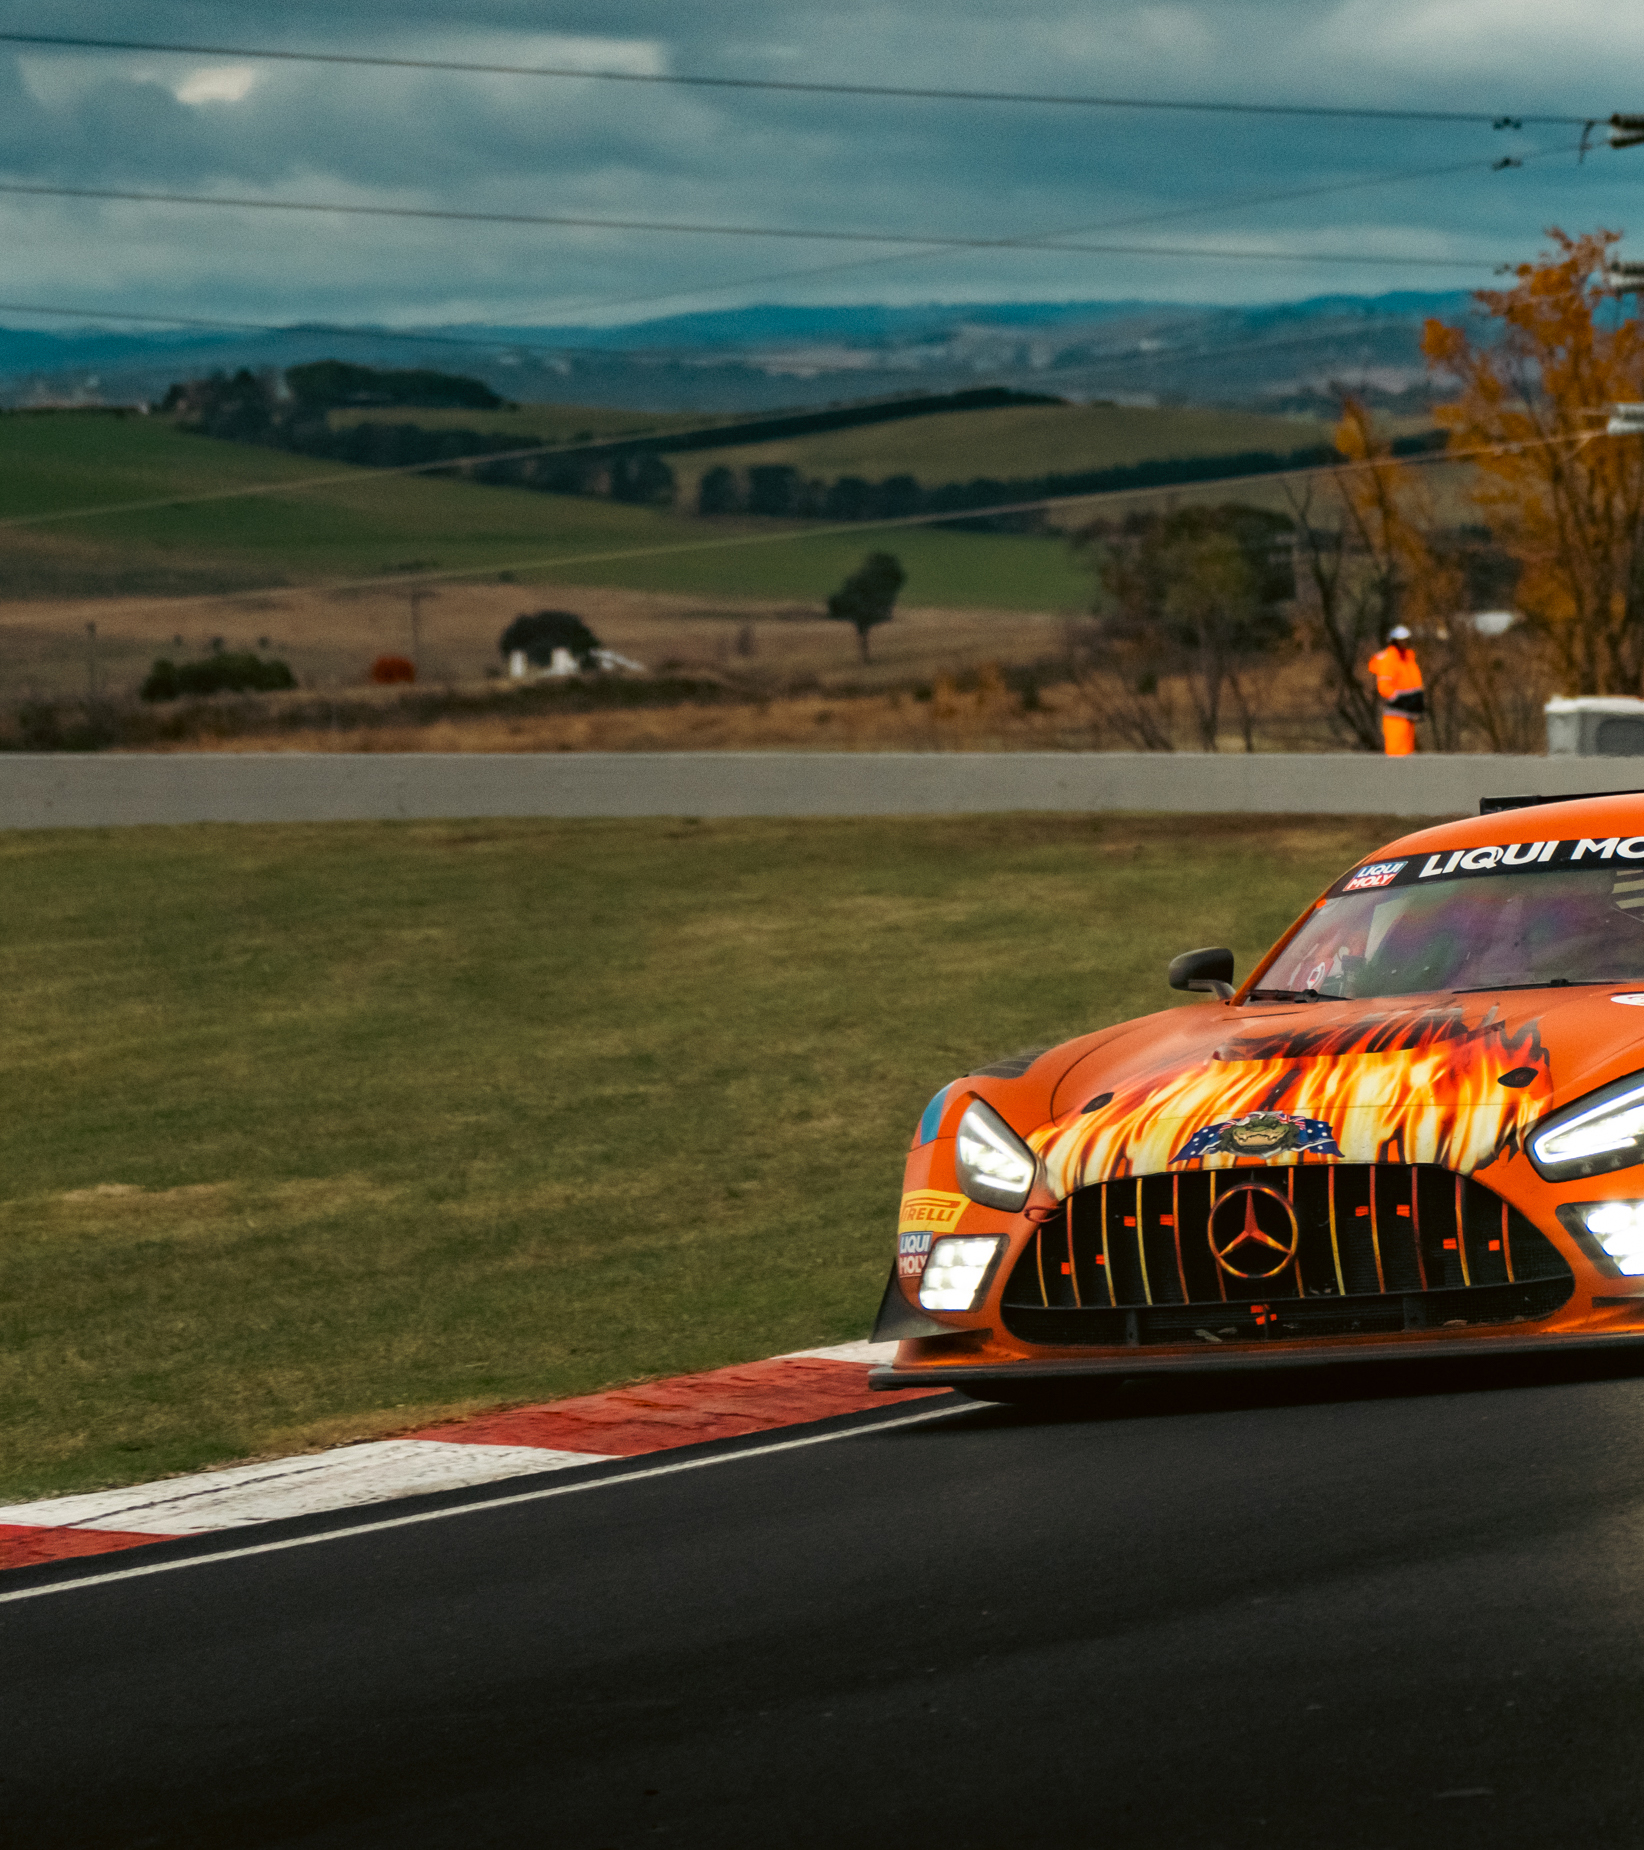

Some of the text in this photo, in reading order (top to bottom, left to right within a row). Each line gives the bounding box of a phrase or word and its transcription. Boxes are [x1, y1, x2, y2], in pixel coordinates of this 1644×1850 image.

[1418, 840, 1560, 878] LIQUI
[1357, 862, 1404, 878] LIQUI
[1346, 873, 1395, 889] MOLY
[901, 1197, 961, 1222] PIRELLI
[901, 1234, 931, 1254] LIQUI
[899, 1254, 928, 1275] MOLY
